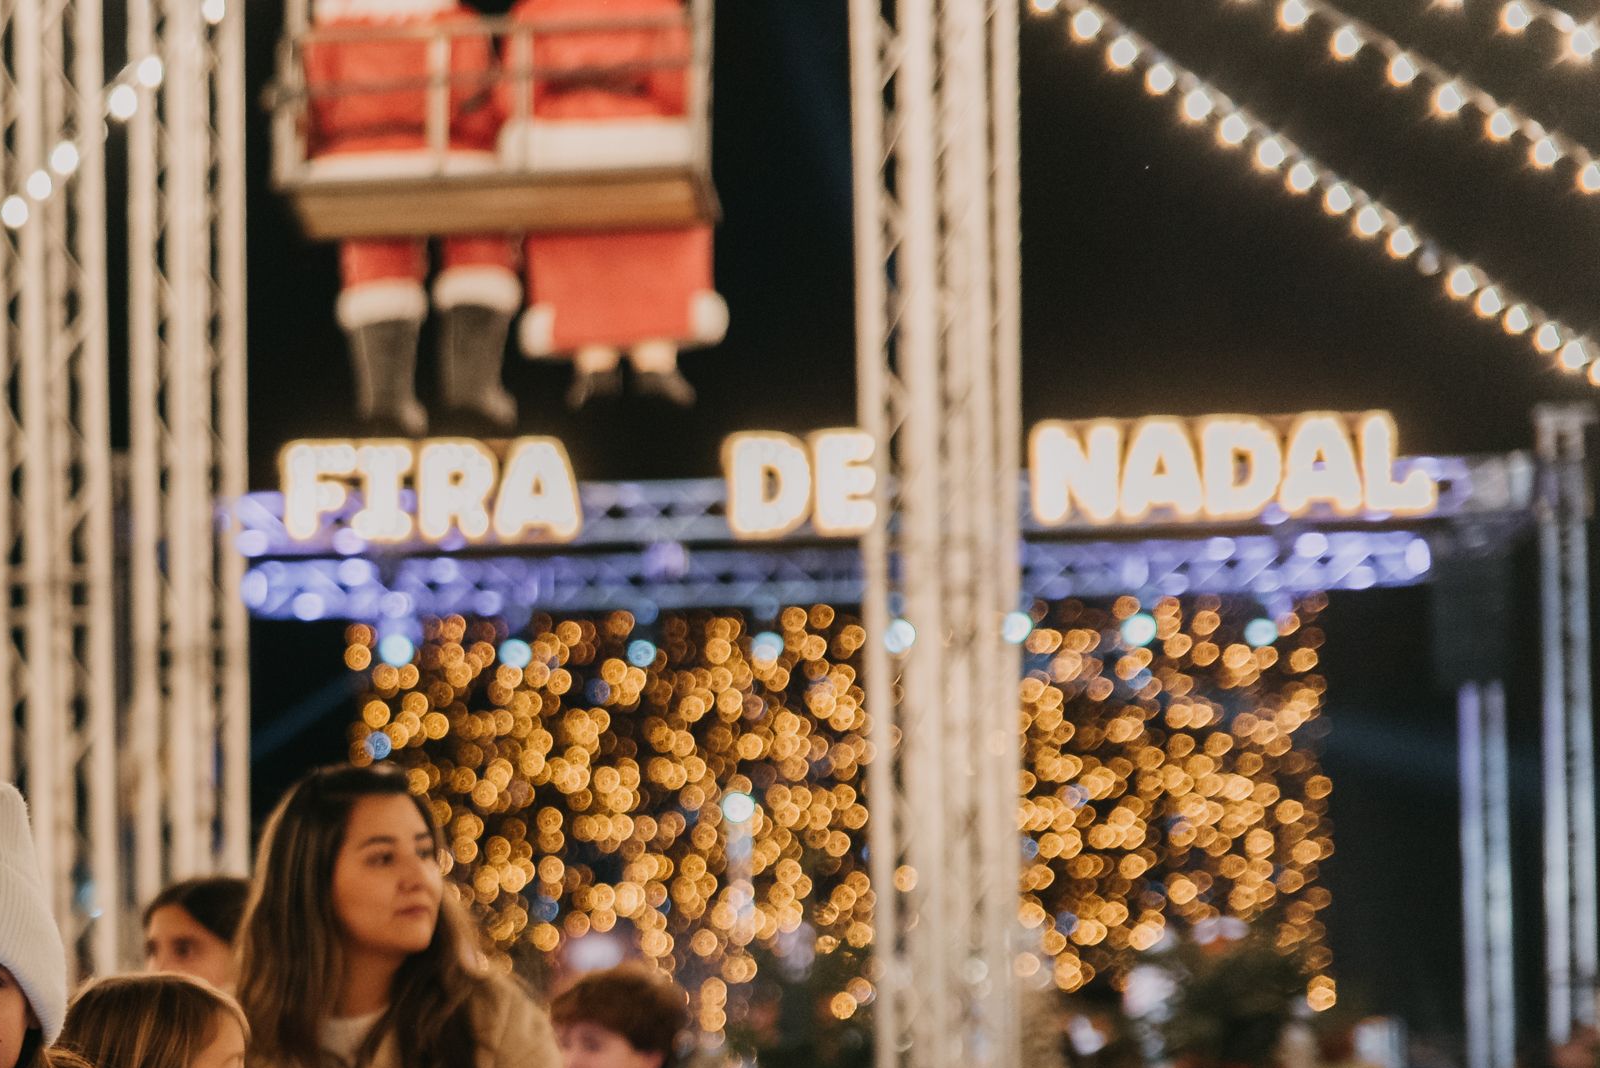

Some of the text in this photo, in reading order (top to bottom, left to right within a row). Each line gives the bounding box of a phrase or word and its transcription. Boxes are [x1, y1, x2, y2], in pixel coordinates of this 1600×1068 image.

[281, 410, 1437, 543] FIRA DE NADAL
